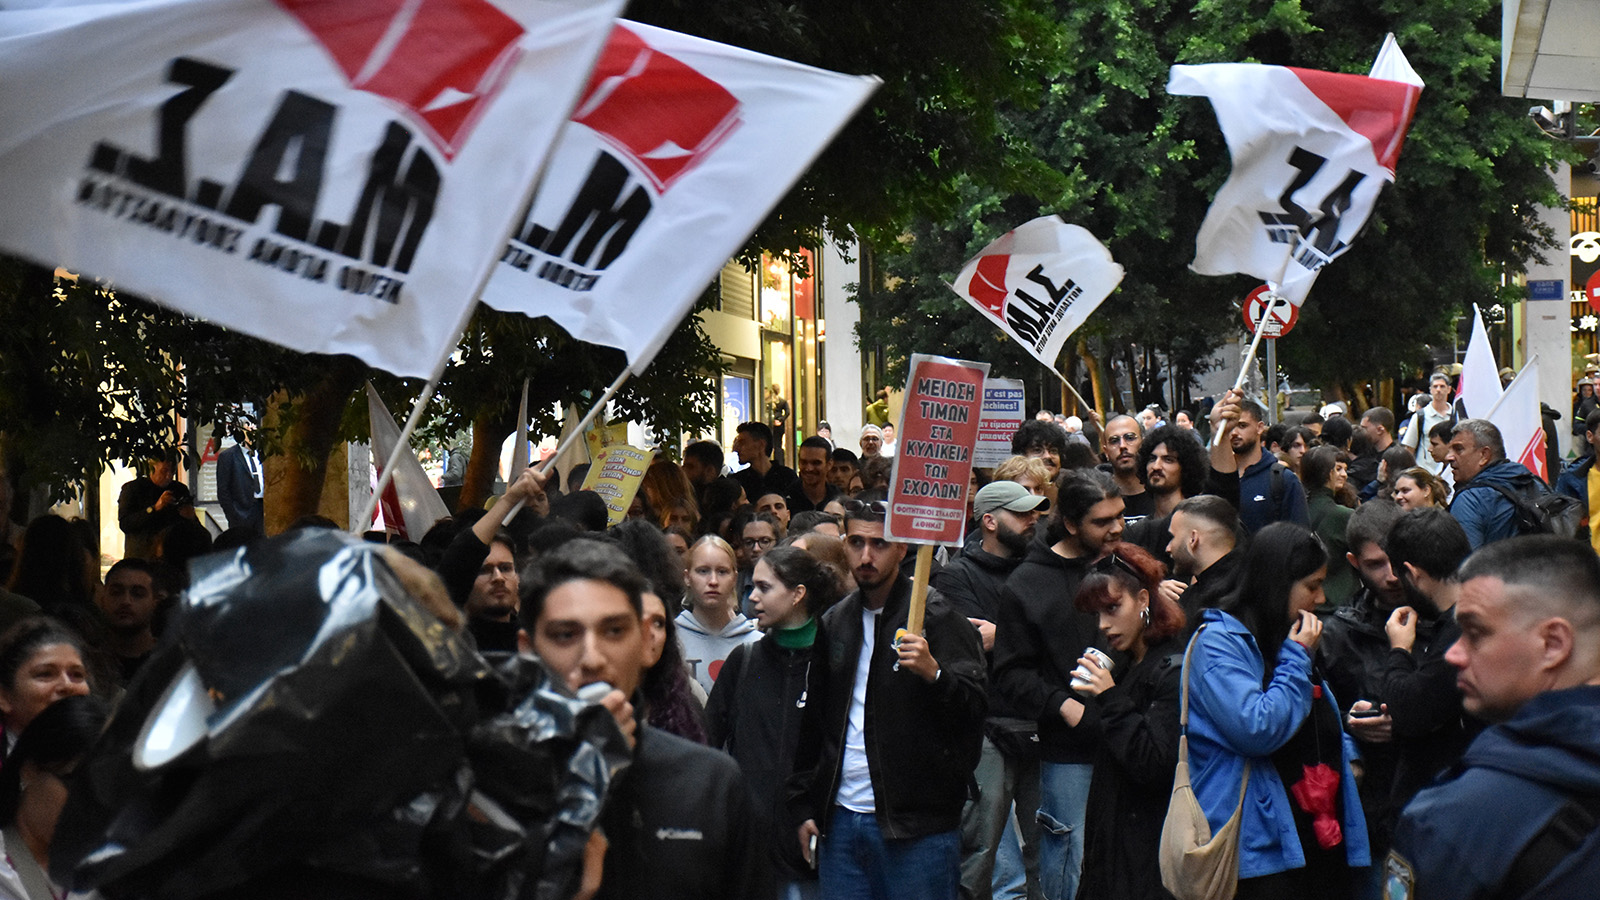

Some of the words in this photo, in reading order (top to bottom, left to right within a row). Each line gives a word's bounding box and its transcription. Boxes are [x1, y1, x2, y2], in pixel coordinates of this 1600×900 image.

[917, 377, 975, 401] ΜΕΙΩΣΗ
[994, 390, 1006, 398] est
[1007, 391, 1023, 399] pas
[920, 400, 969, 423] ΤΙΜΩΝ
[983, 401, 1017, 410] achines!
[929, 425, 953, 440] ΣΤΑ
[906, 440, 969, 462] ΚΥΛΙΚΕΙΑ
[924, 463, 949, 479] ΤΩΝ
[902, 478, 963, 500] ΣΧΟΛΩΝ!
